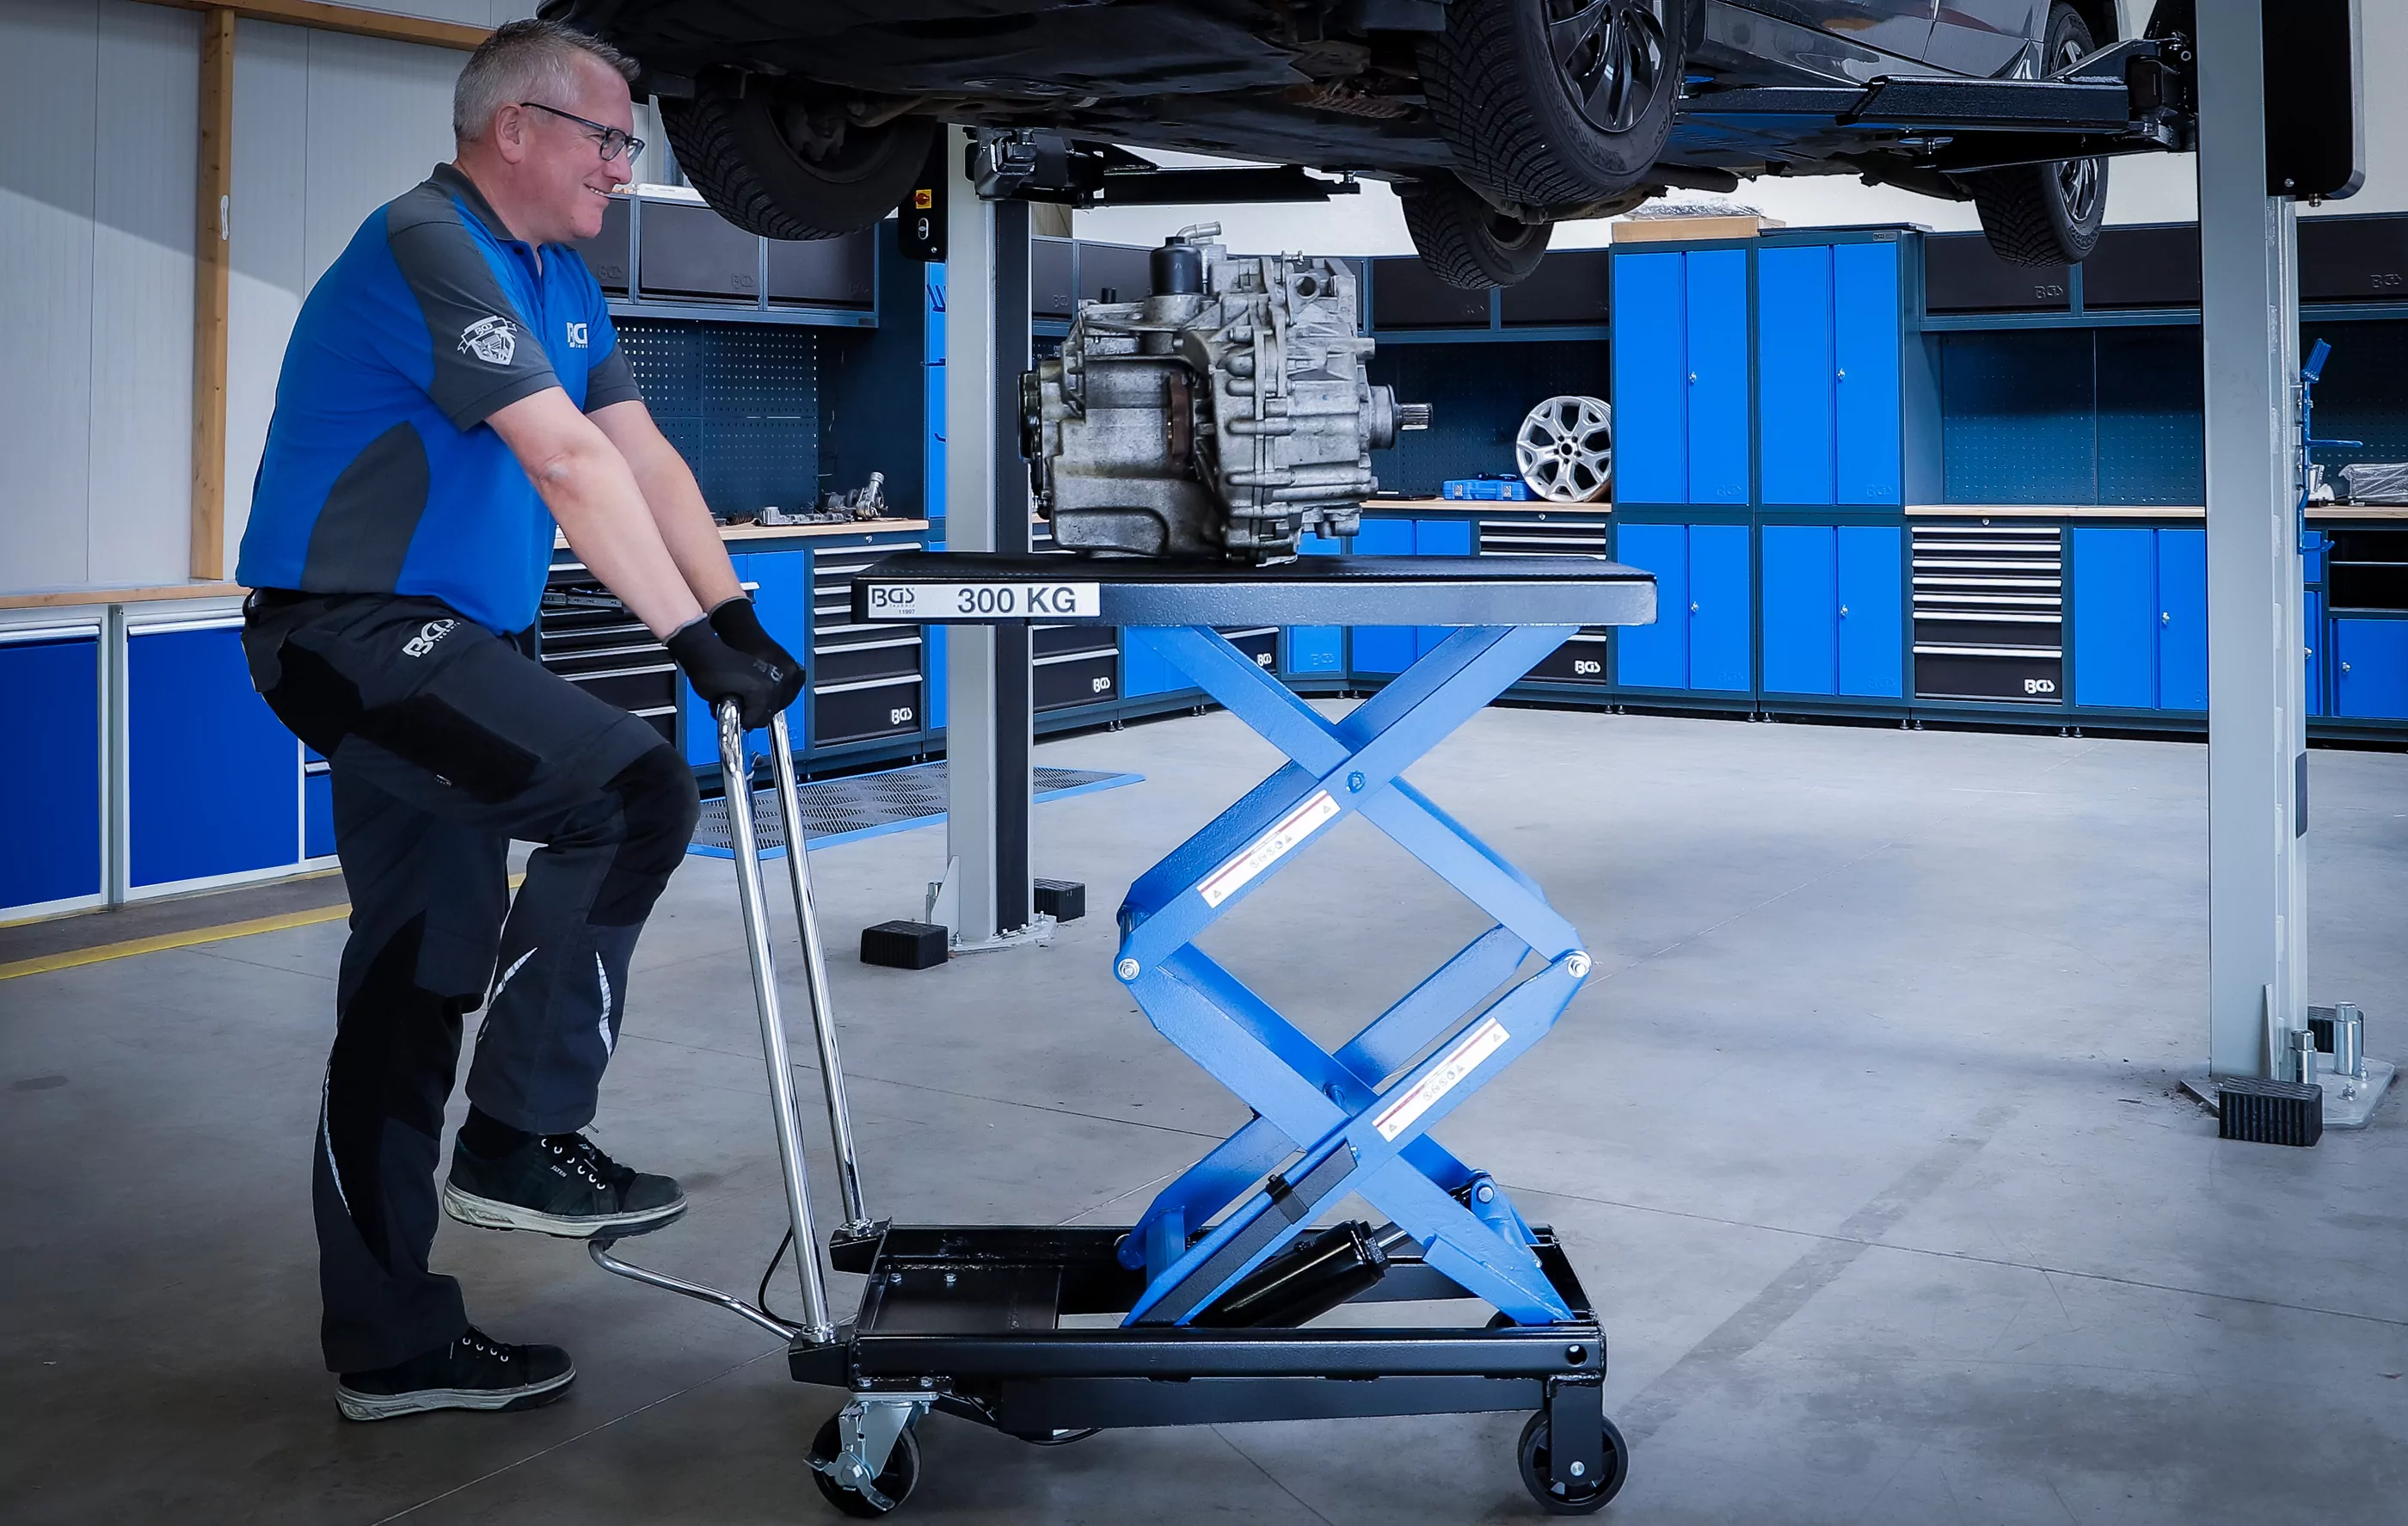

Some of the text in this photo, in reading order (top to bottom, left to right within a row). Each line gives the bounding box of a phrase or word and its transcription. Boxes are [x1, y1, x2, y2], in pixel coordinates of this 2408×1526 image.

[2034, 285, 2063, 298] BGS
[566, 322, 588, 348] BG
[871, 588, 915, 607] BGS
[957, 587, 1076, 613] 300 KG
[402, 618, 455, 658] BGS
[1256, 653, 1272, 667] BGS
[1575, 660, 1600, 674] BGS
[1092, 676, 1110, 692] BGS
[2024, 679, 2055, 693] BGS
[891, 707, 912, 724] BGS
